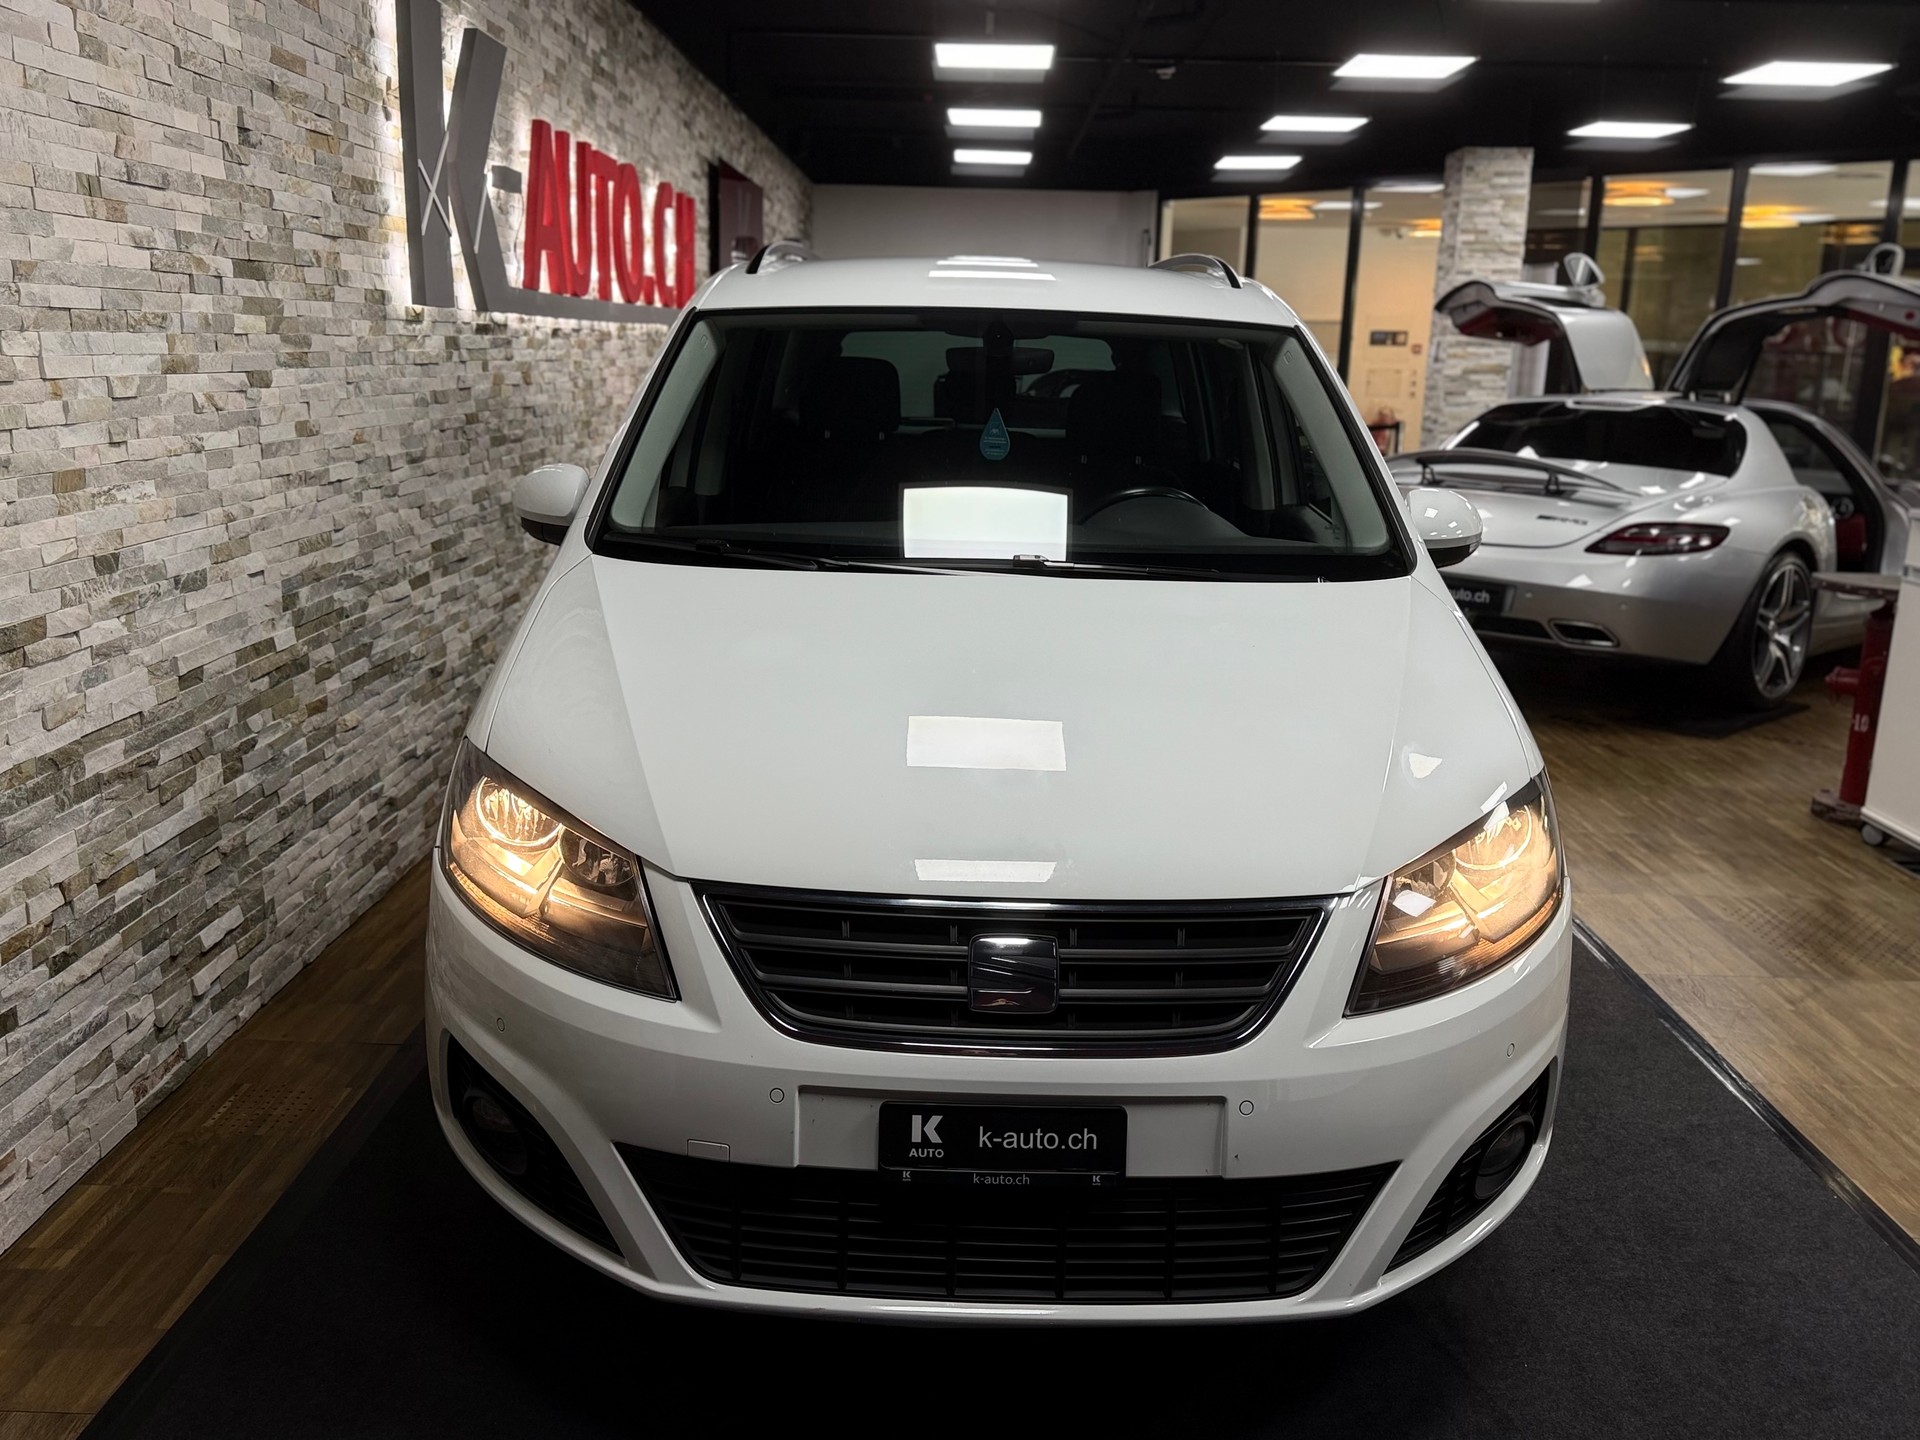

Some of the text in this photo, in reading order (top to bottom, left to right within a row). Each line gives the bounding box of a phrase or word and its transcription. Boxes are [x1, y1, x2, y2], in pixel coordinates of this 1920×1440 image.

[396, 0, 697, 311] K-AUTO.CH
[1450, 588, 1491, 604] uto.ch
[911, 1114, 944, 1144] K
[979, 1126, 1098, 1151] k-auto.ch
[908, 1148, 945, 1158] AUTO
[973, 1173, 1030, 1185] k-auto.ch
